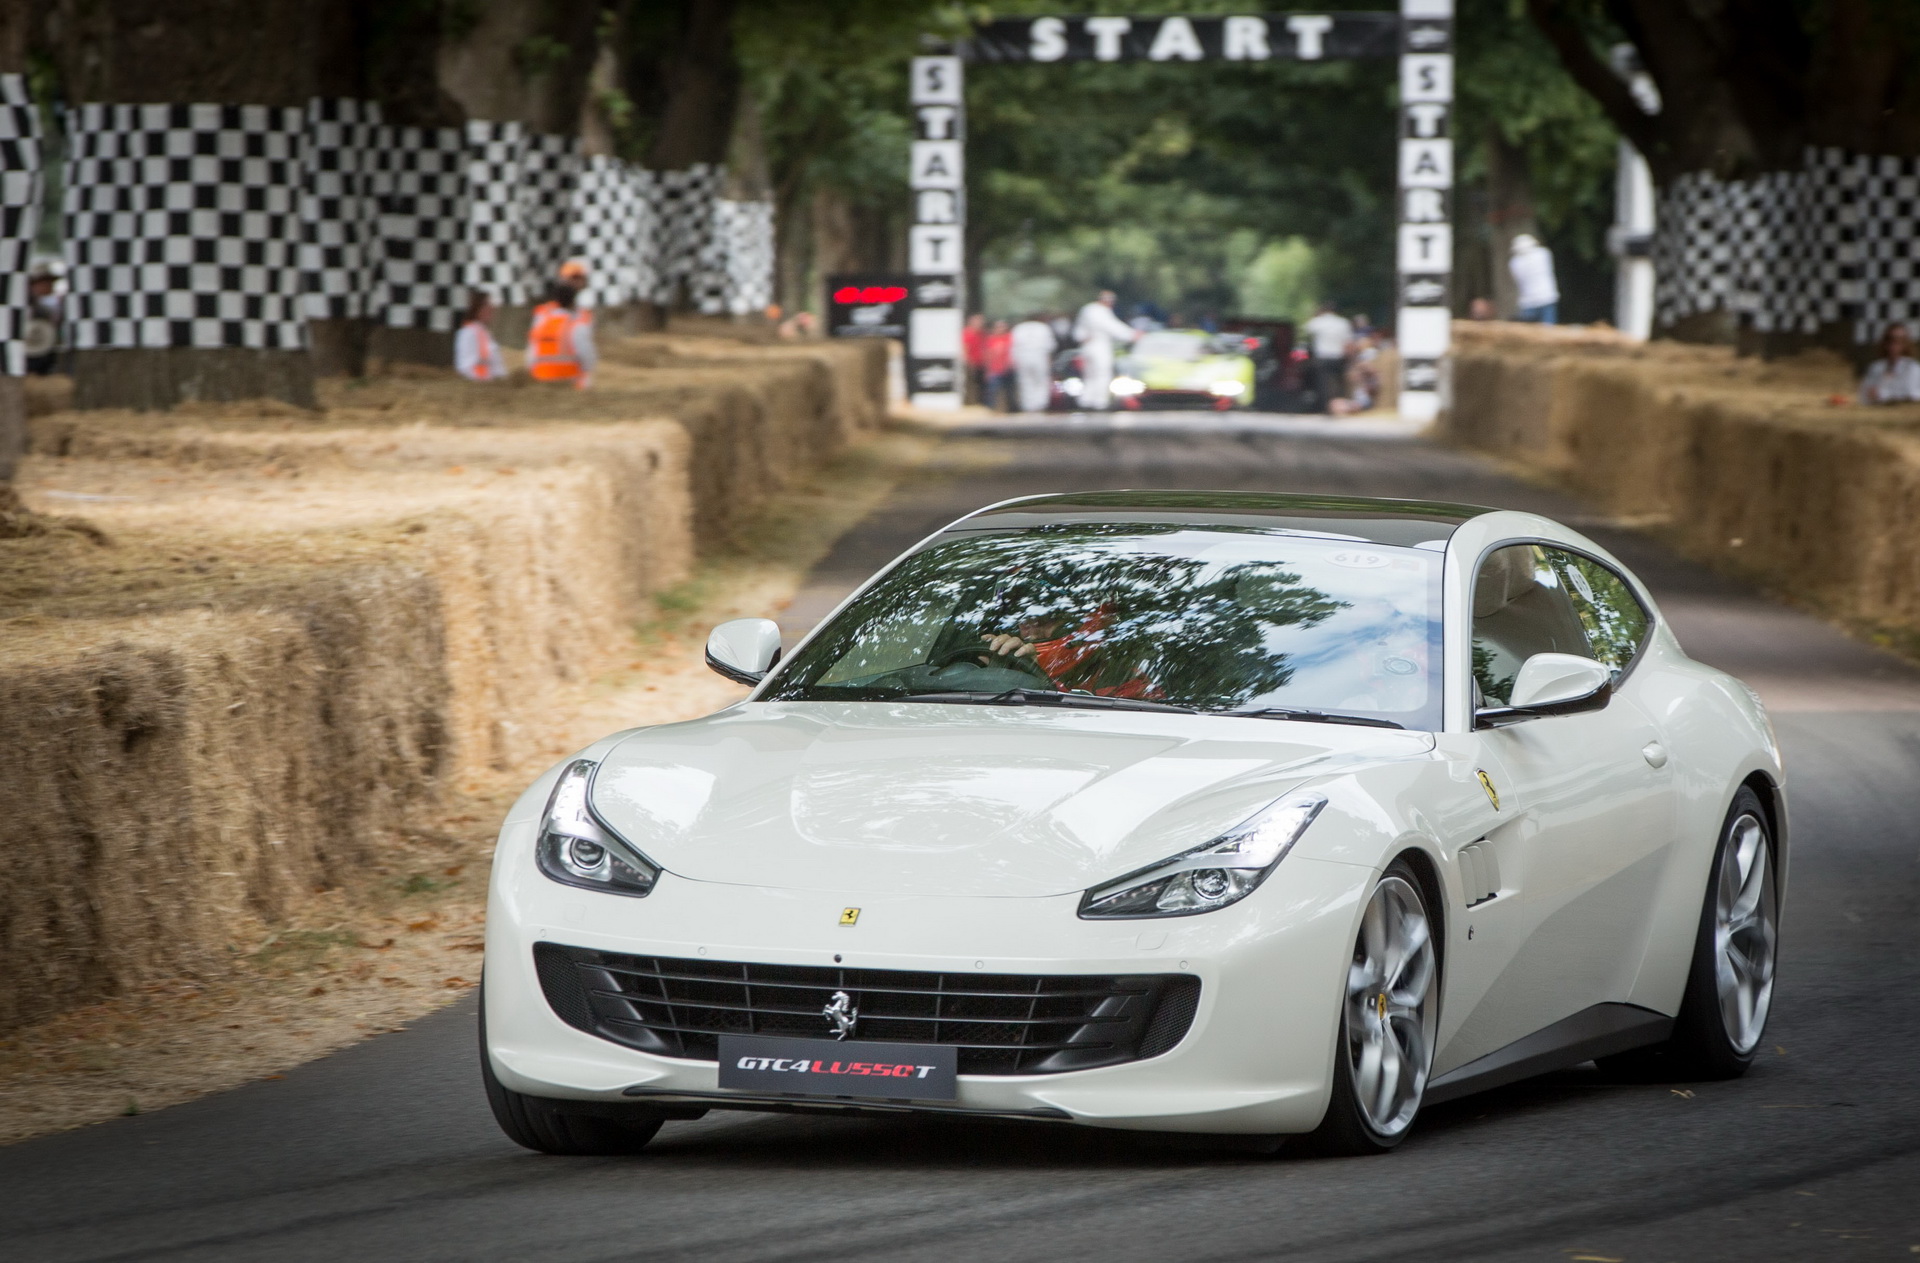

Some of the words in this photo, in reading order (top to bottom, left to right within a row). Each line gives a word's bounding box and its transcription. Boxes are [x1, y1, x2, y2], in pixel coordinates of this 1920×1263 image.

[1029, 15, 1334, 62] START
[917, 63, 954, 263] START
[1406, 64, 1447, 261] START
[1334, 553, 1380, 565] 619
